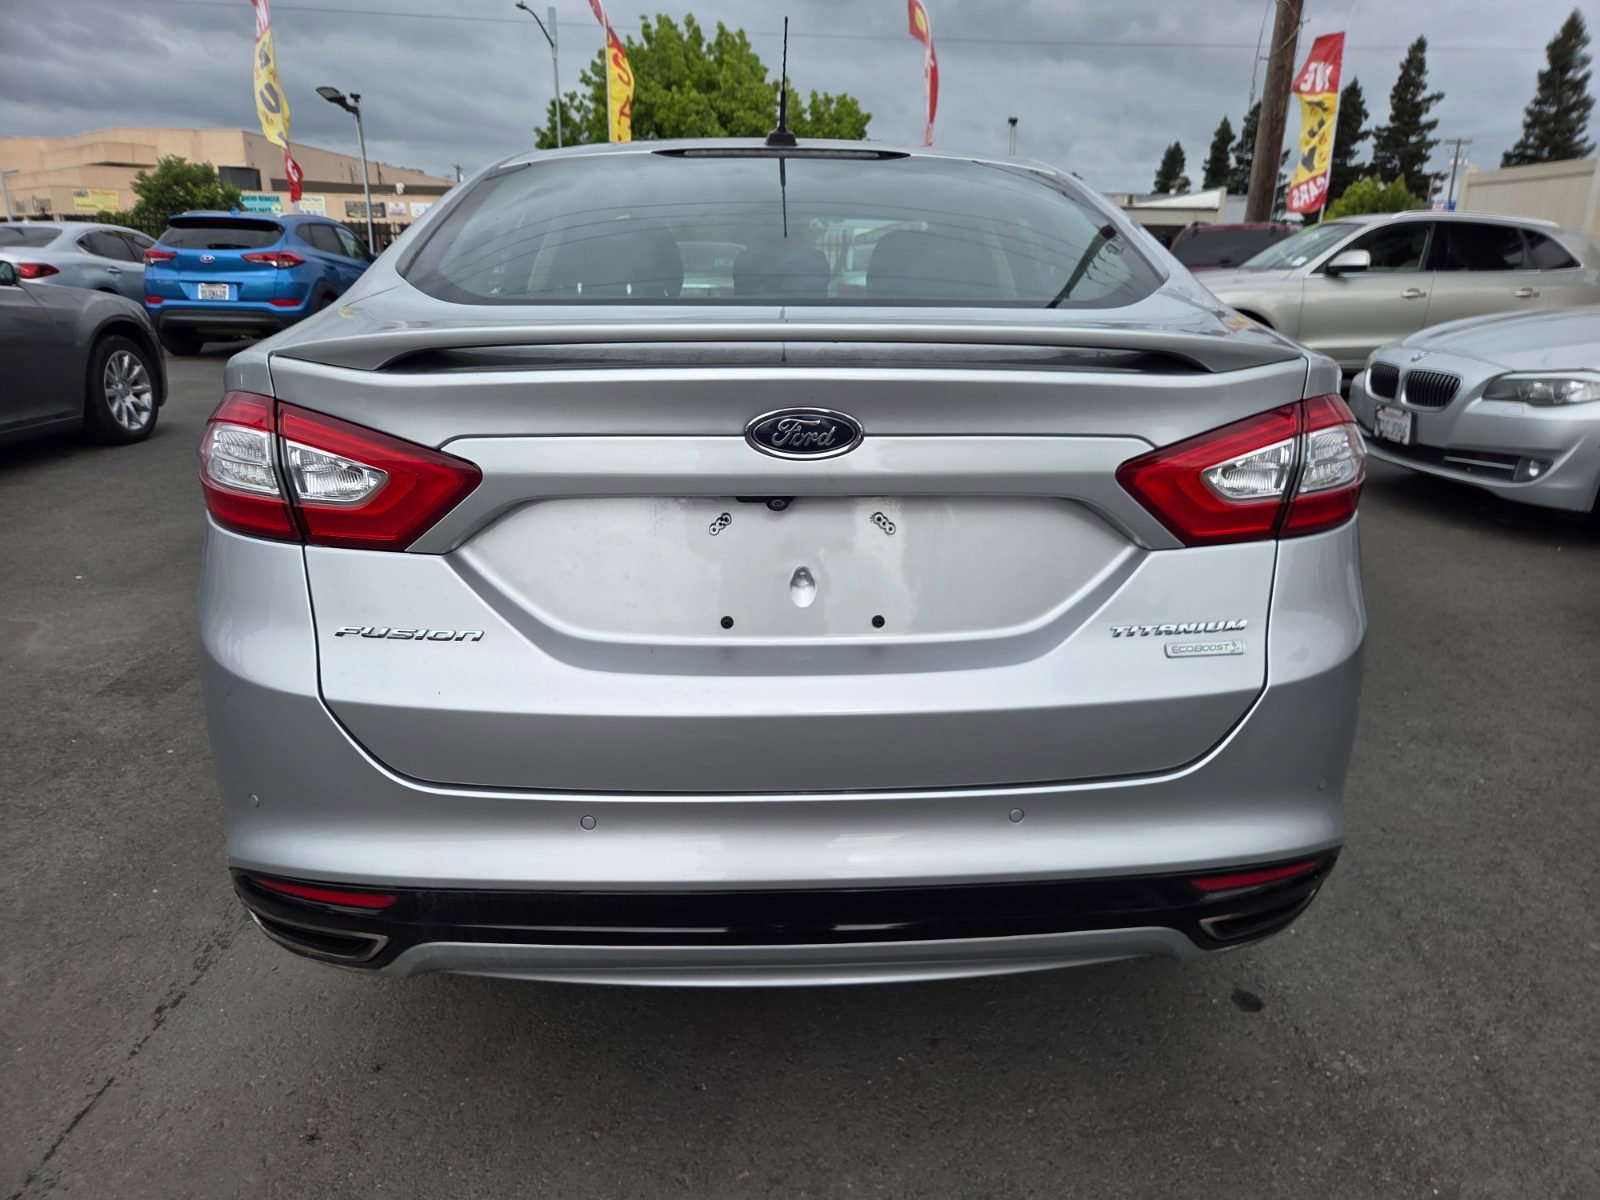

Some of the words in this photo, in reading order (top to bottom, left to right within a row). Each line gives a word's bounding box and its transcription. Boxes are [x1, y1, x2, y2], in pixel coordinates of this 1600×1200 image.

[771, 418, 837, 447] Ford
[1109, 619, 1248, 638] TITANIUM
[1170, 643, 1231, 655] ECOBOOST
